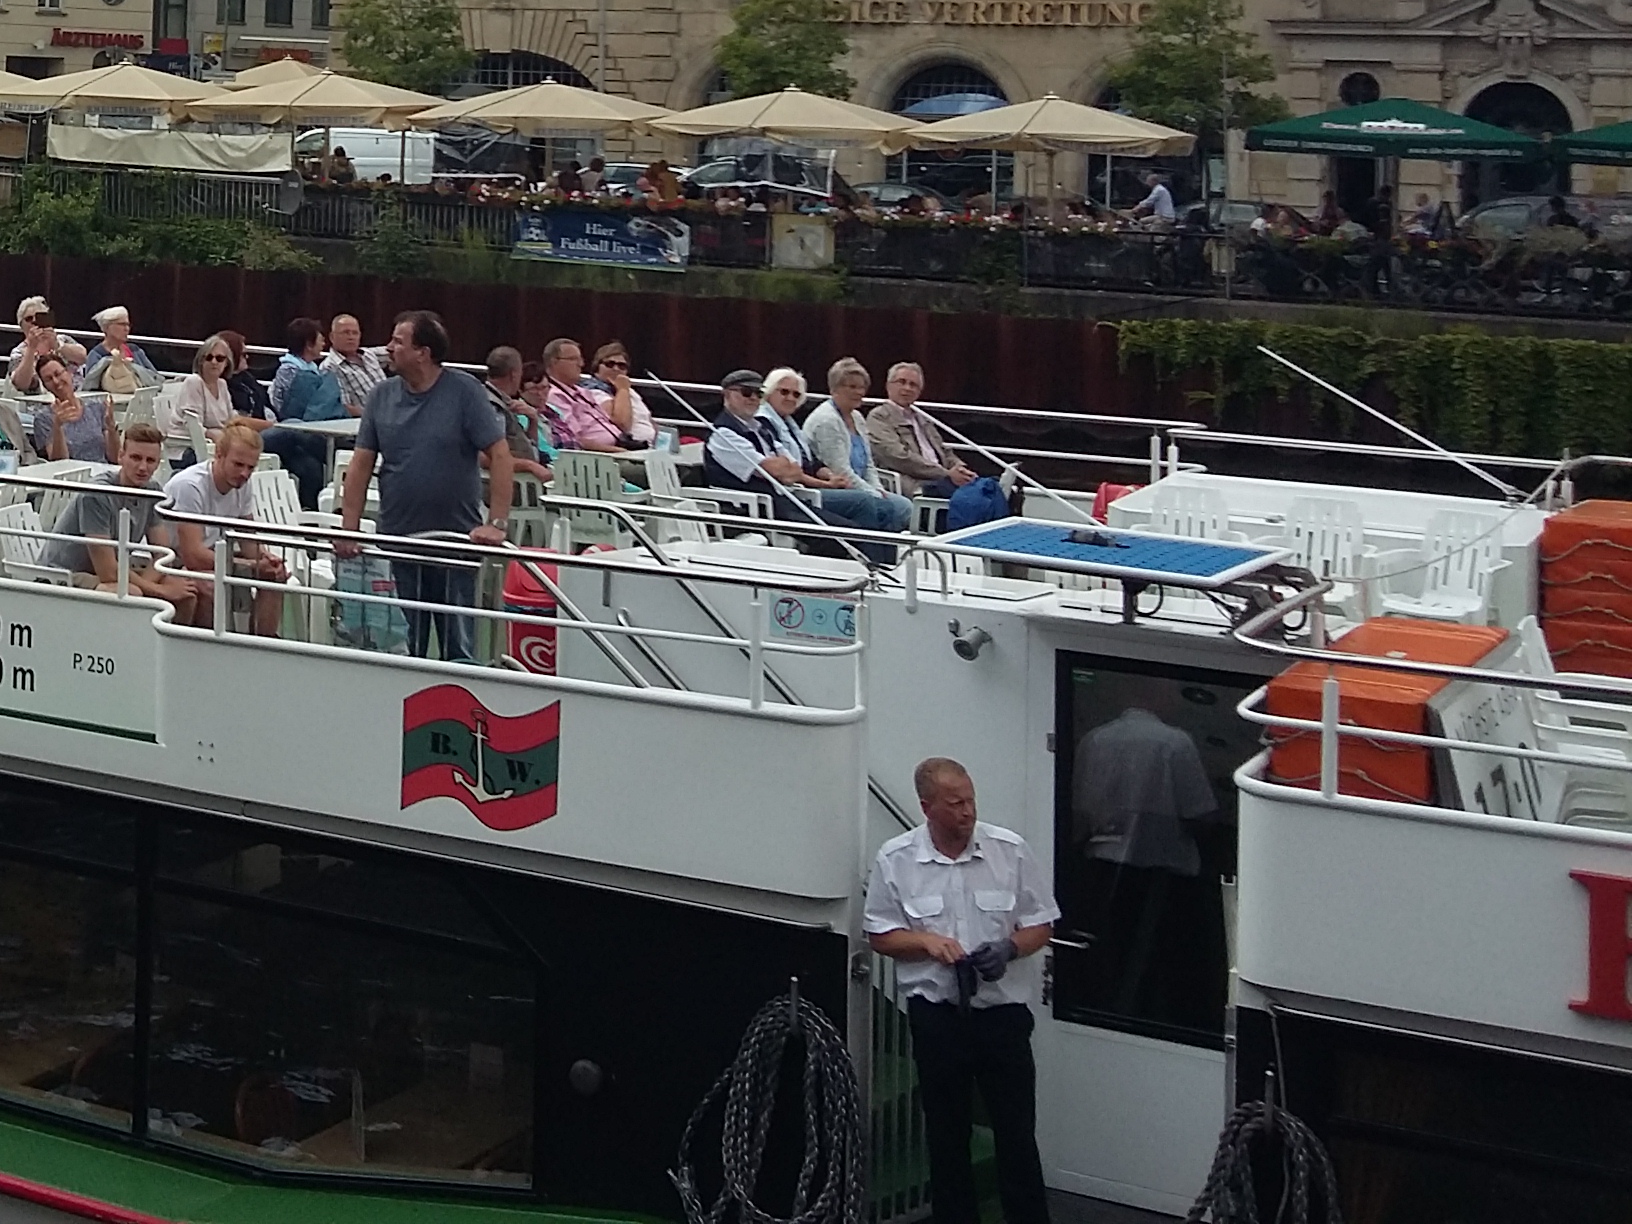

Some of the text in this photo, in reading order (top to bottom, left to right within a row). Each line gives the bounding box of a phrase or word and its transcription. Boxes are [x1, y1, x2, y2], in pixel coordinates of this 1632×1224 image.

[51, 28, 144, 50] ÄRZTEHAUS
[585, 223, 617, 236] Hier
[560, 237, 641, 255] Fußball live!
[10, 622, 32, 648] m
[87, 655, 115, 675] 250
[12, 666, 35, 692] m
[430, 731, 458, 756] B.
[506, 758, 541, 786] W.
